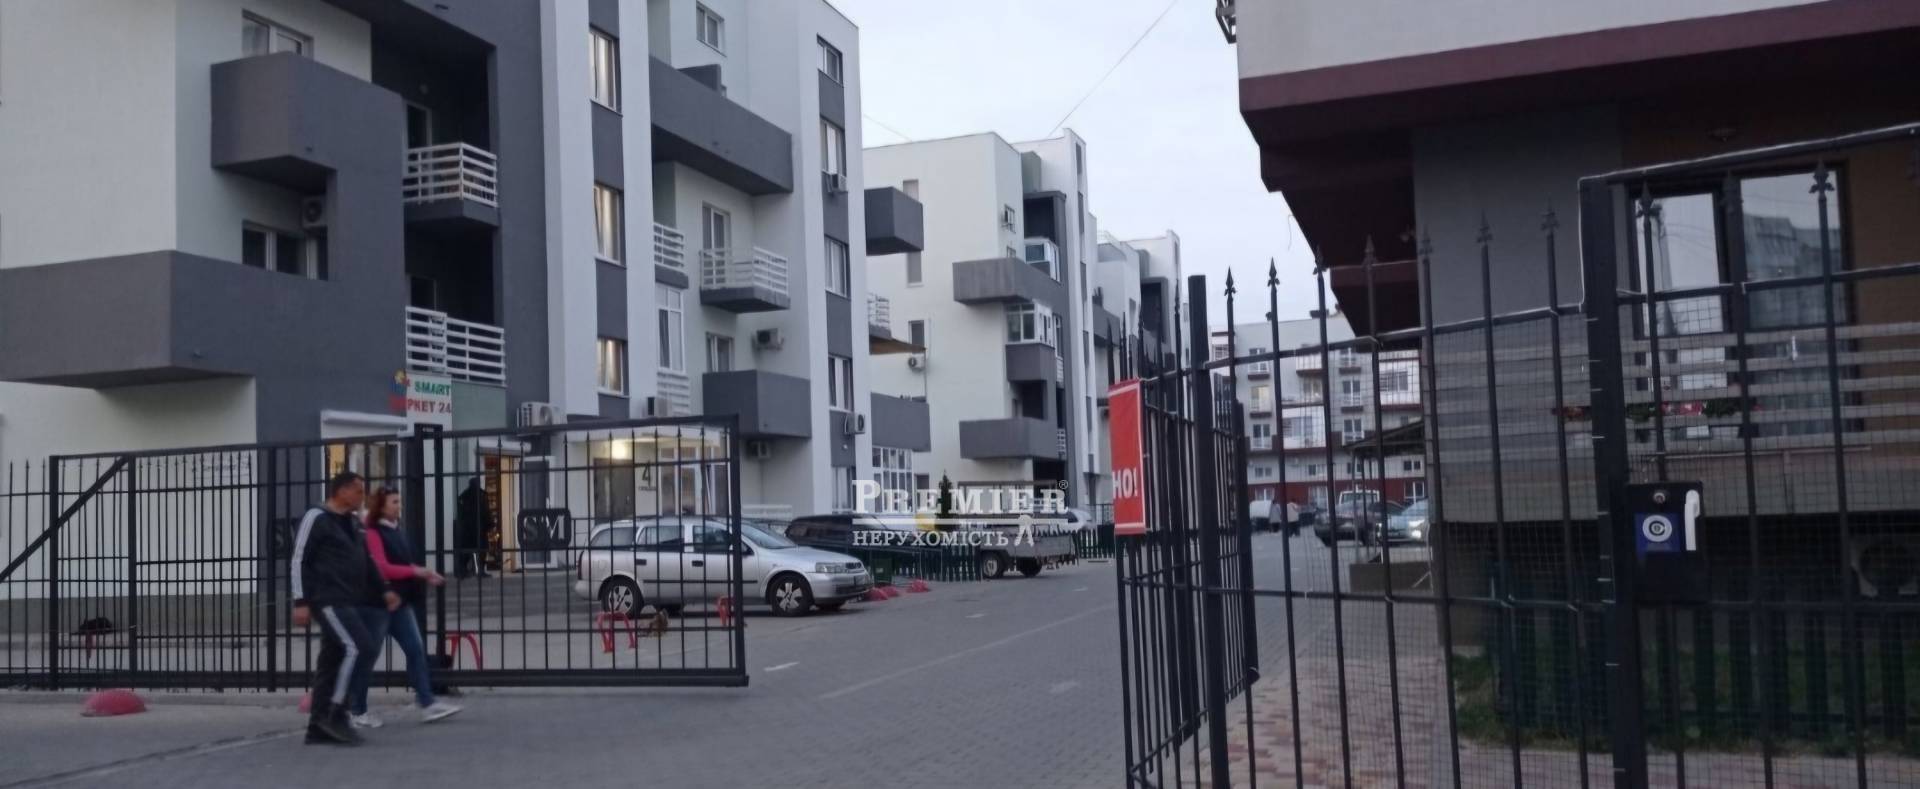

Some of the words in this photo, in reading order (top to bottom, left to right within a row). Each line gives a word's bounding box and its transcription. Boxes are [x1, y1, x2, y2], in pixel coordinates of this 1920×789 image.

[415, 381, 451, 397] SMART
[439, 402, 451, 414] 24
[642, 460, 651, 488] 4
